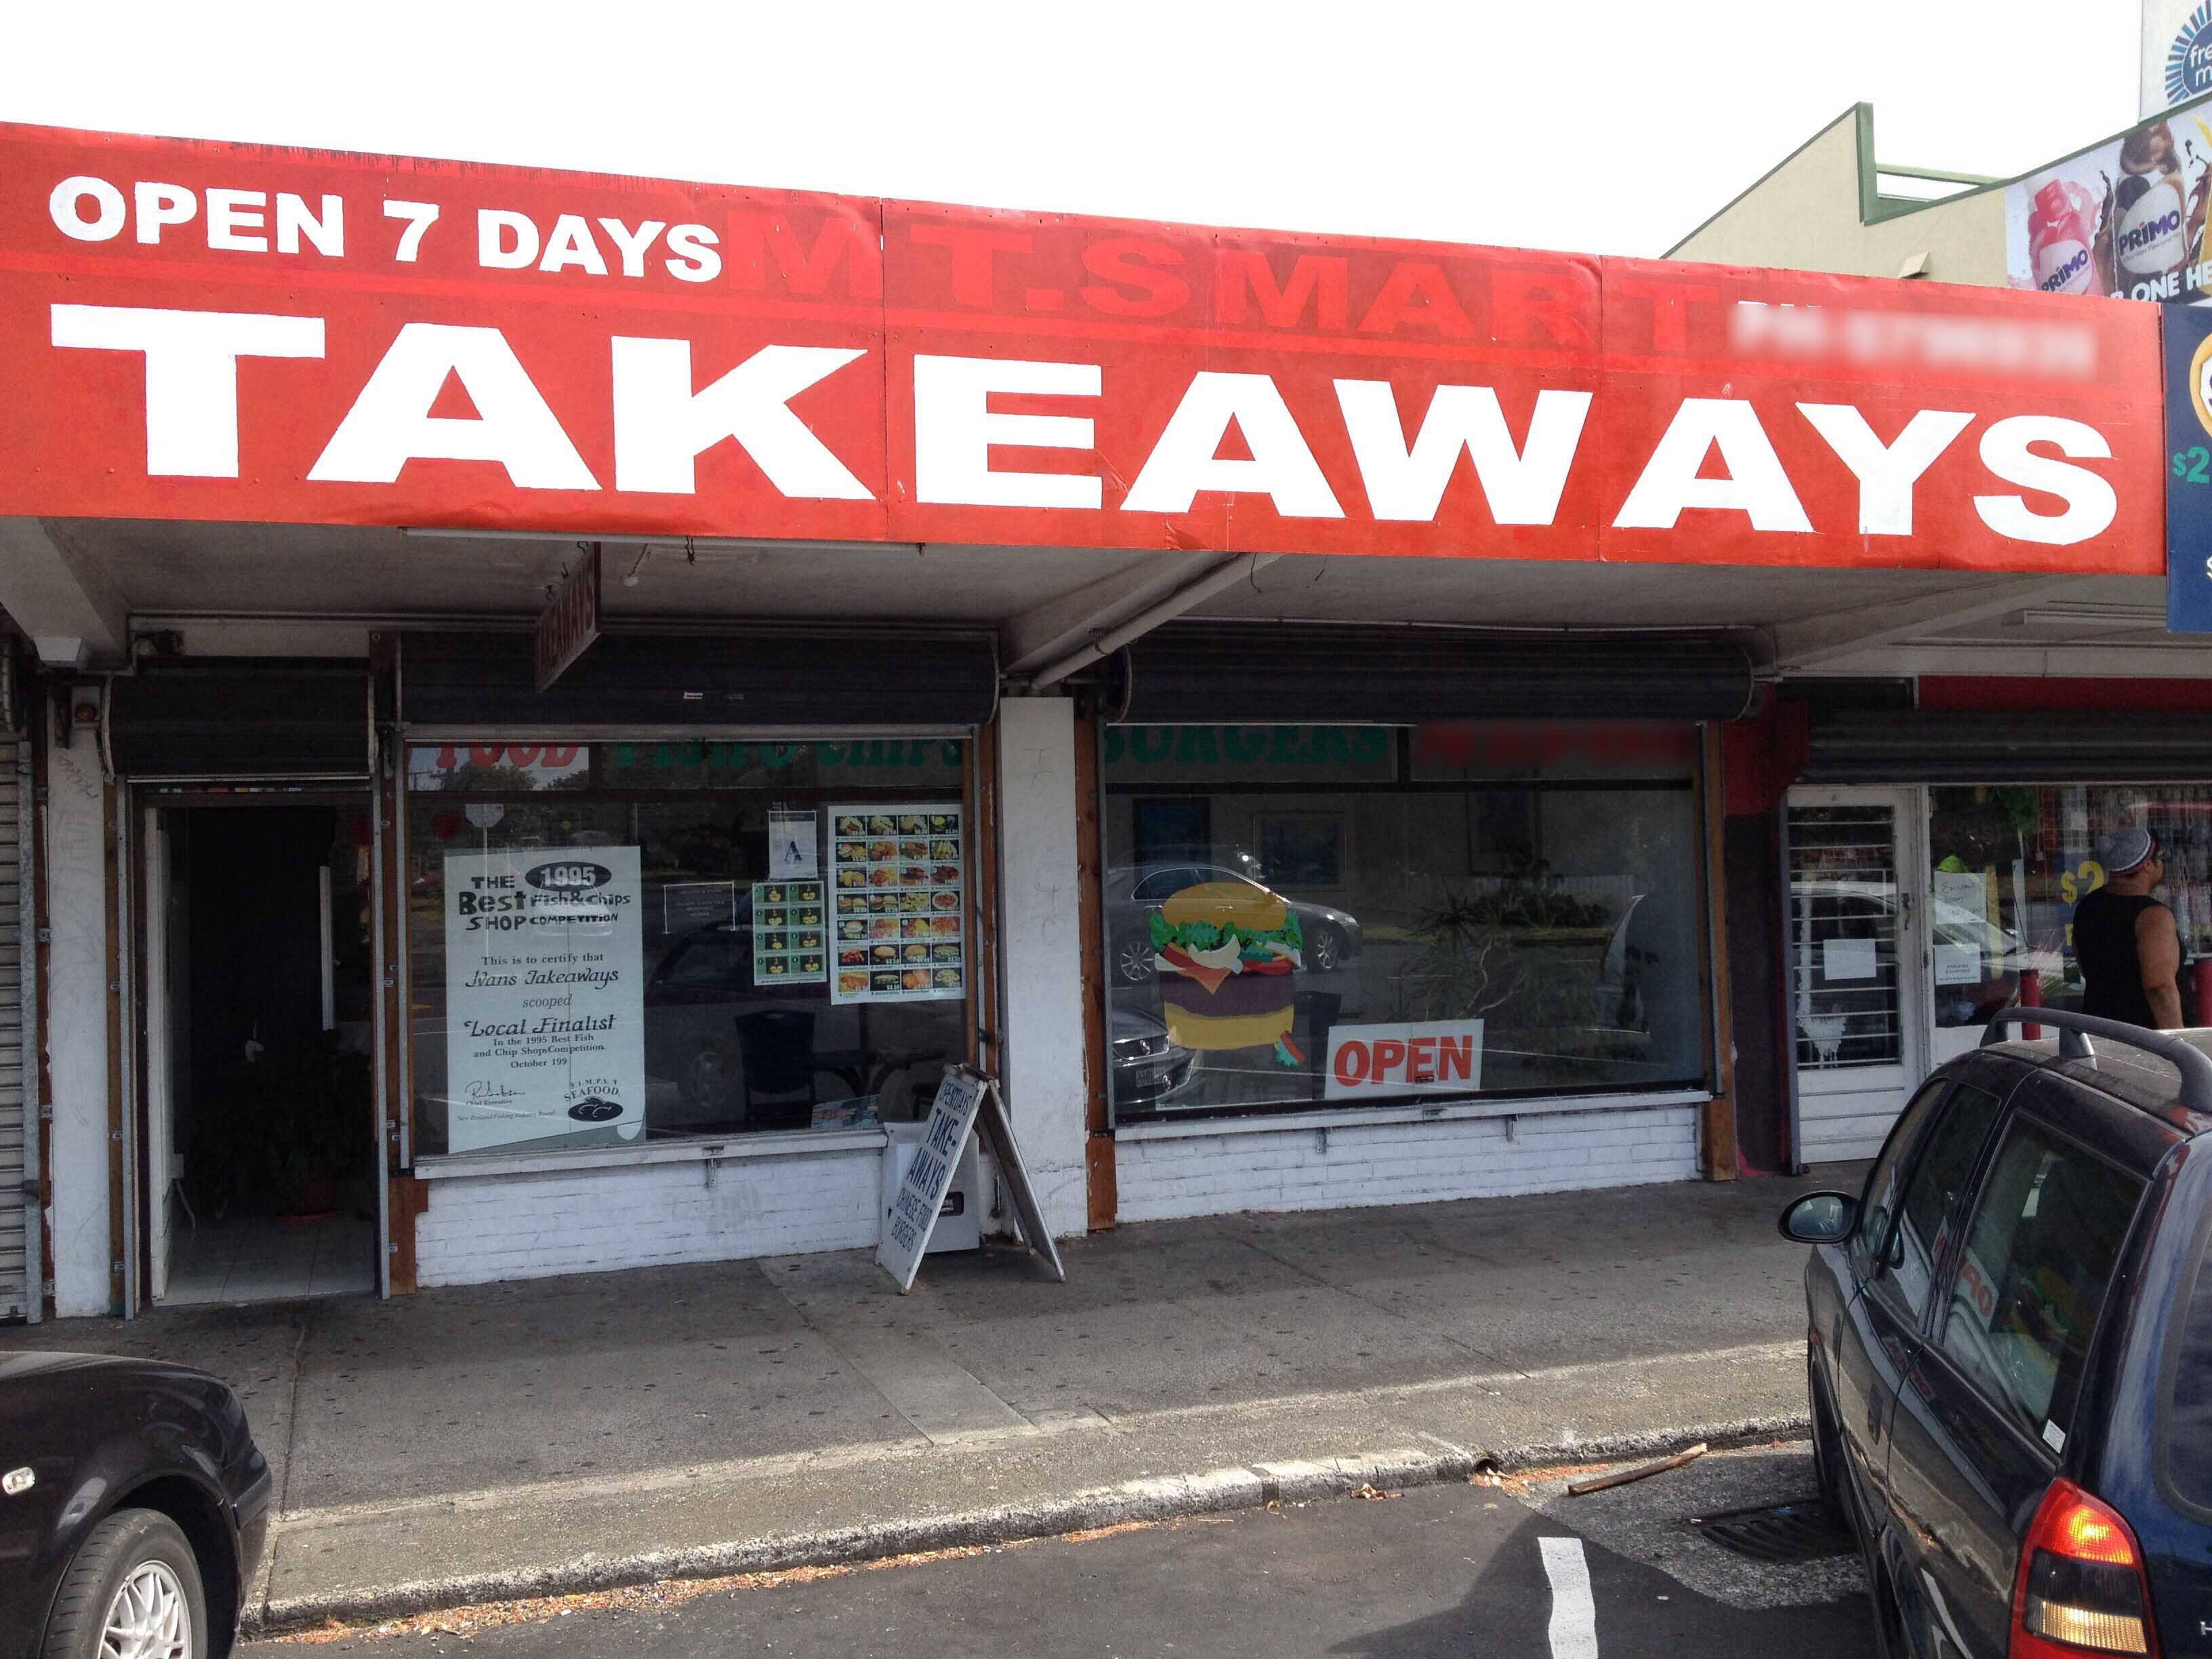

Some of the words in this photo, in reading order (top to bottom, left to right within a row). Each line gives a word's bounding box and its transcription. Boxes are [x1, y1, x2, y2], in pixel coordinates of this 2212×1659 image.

[50, 176, 344, 256] OPEN
[384, 200, 438, 261] 7
[478, 209, 721, 283] DAYS
[2131, 272, 2179, 302] ONE
[51, 304, 2119, 545] TAKEAWAYS
[471, 875, 515, 889] THE
[540, 867, 596, 886] 1995
[459, 891, 527, 915] Best
[466, 916, 527, 930] SHOP
[481, 956, 508, 966] This
[512, 956, 521, 964] is
[527, 955, 537, 964] to
[542, 953, 578, 965] certify
[582, 952, 604, 962] that
[523, 994, 573, 1009] scooped
[464, 1019, 527, 1037] Local
[532, 1014, 617, 1034] Finalist
[526, 1036, 548, 1044] 1995
[552, 1035, 571, 1043] Best
[575, 1034, 594, 1042] Fish
[474, 1049, 491, 1057] and
[495, 1048, 518, 1057] Chip
[1334, 1035, 1473, 1087] OPEN
[510, 1059, 548, 1069] October
[905, 1147, 946, 1201] AWAYS
